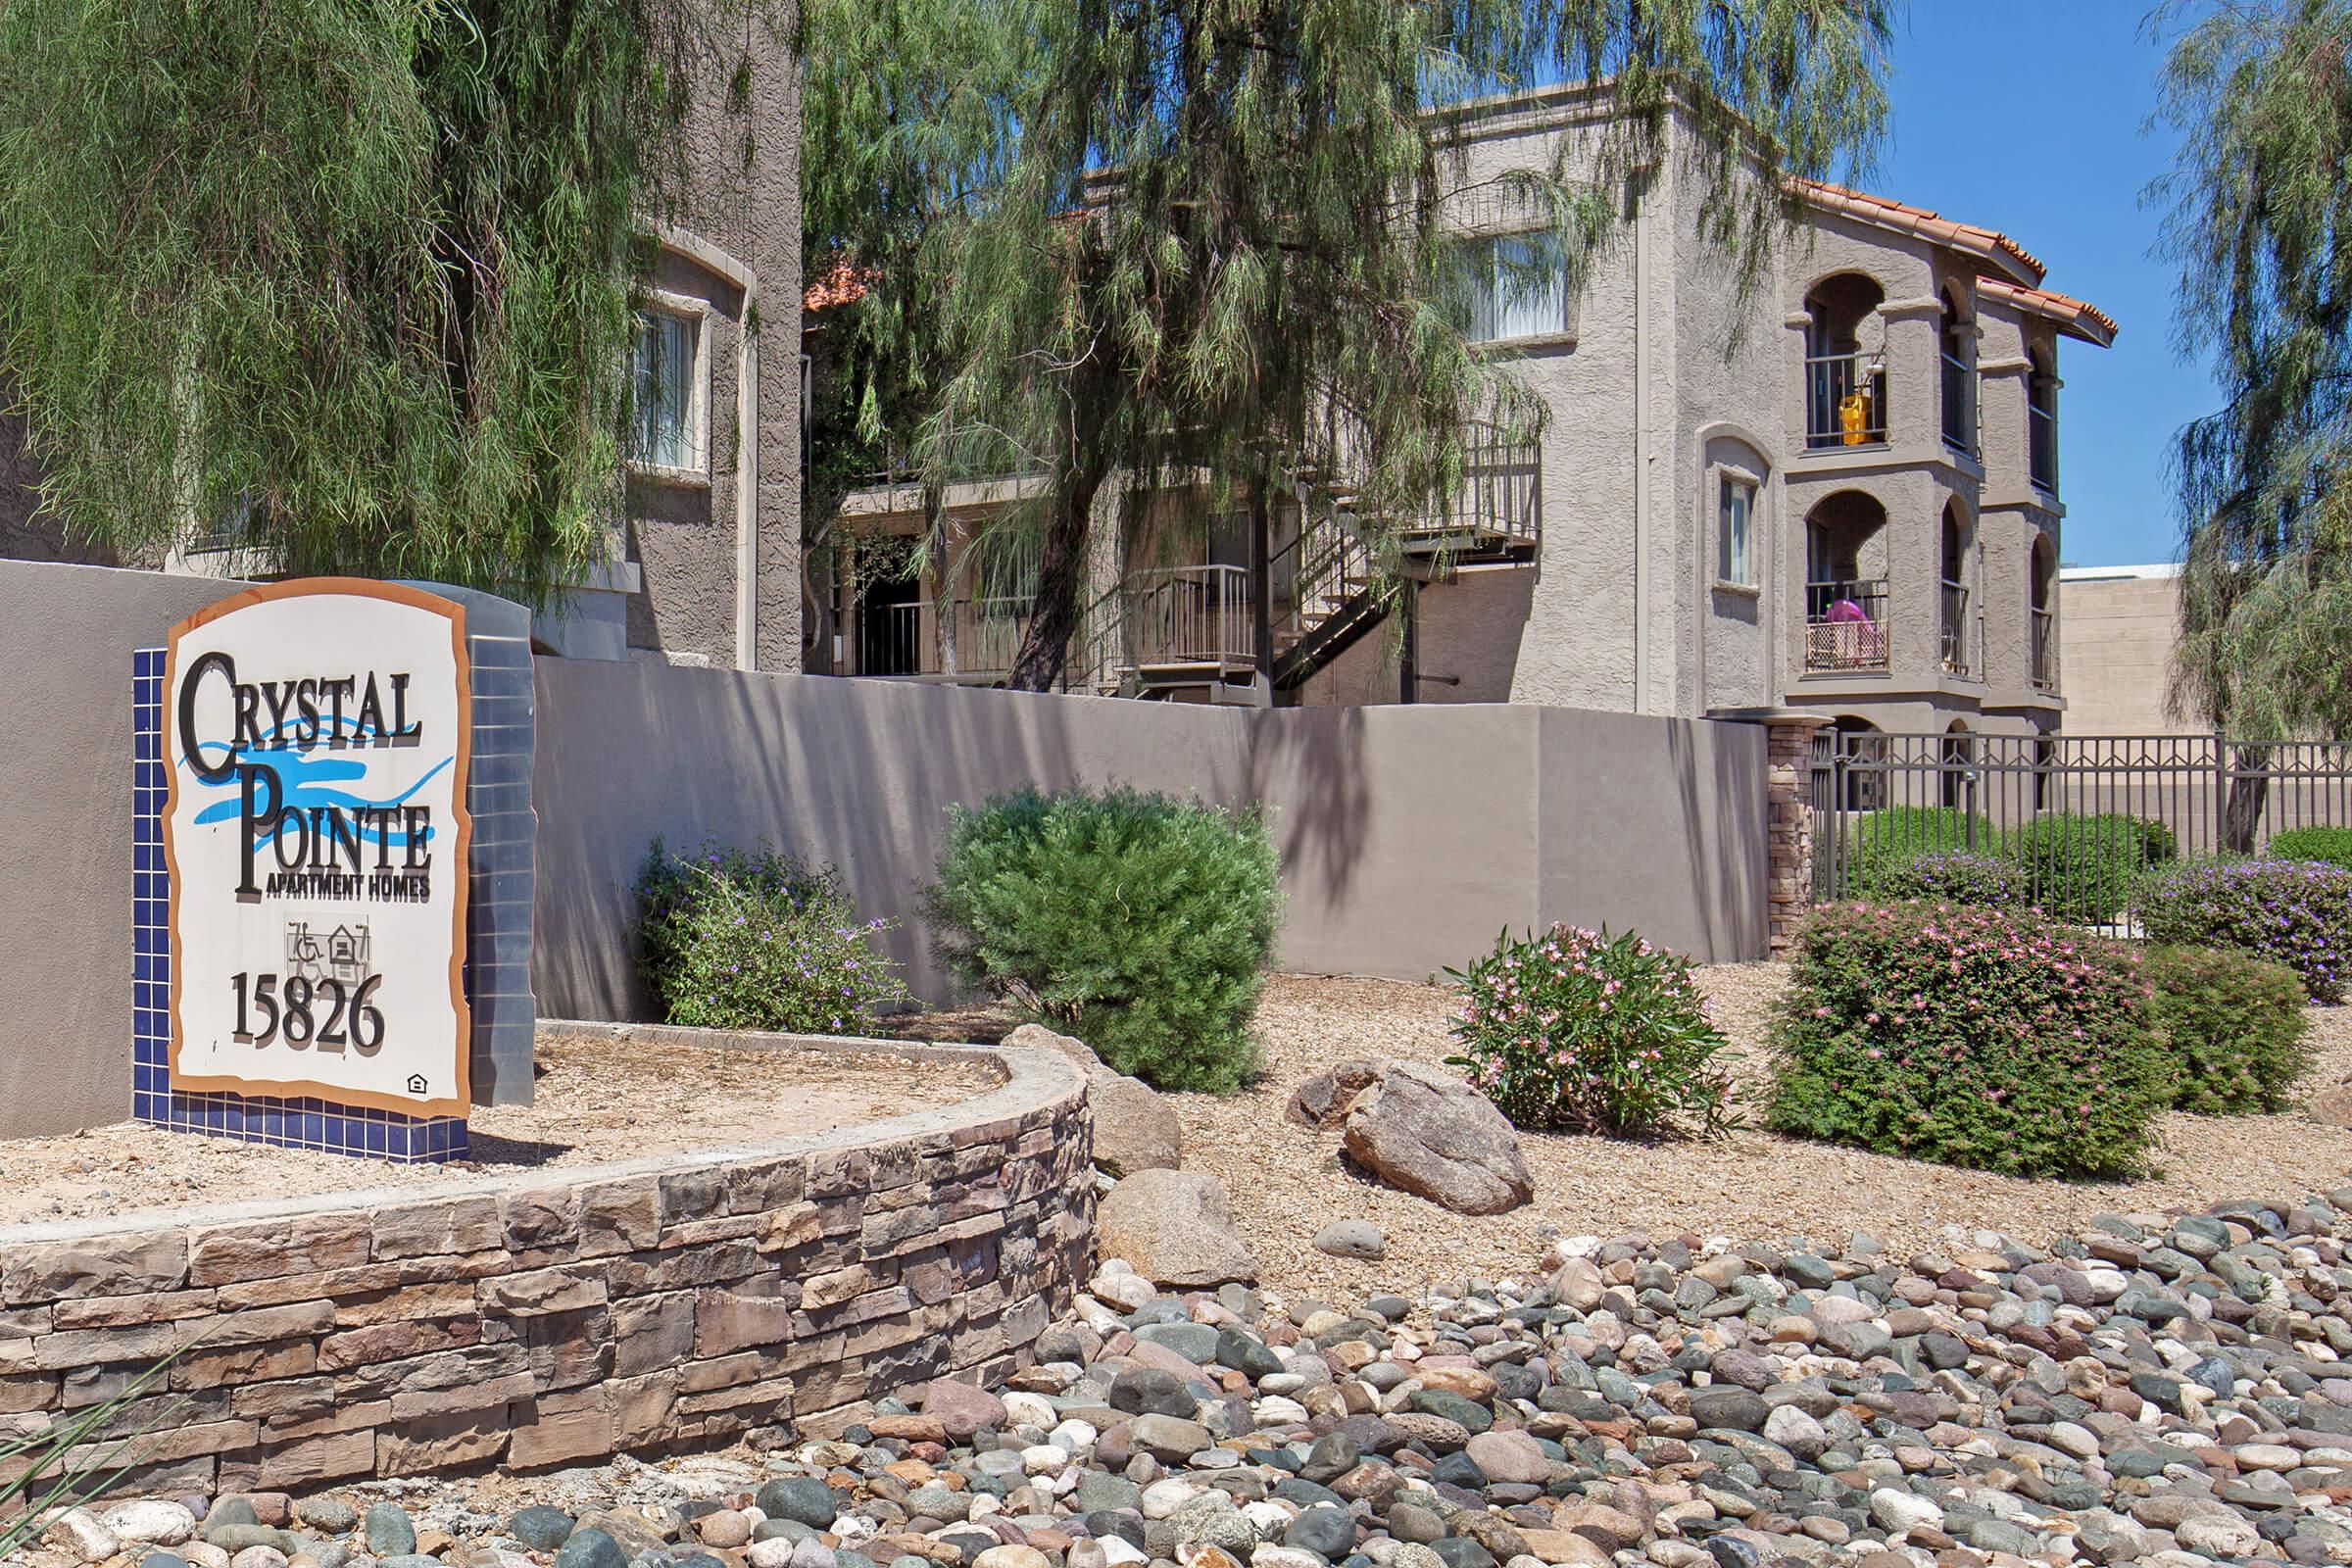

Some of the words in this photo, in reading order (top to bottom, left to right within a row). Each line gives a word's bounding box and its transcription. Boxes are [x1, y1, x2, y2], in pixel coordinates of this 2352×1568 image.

[178, 651, 422, 776] CRYSTAL
[234, 762, 432, 894] POINTE
[267, 873, 365, 896] APARTMENT
[368, 875, 431, 898] HOMES
[230, 971, 385, 1048] 15826
